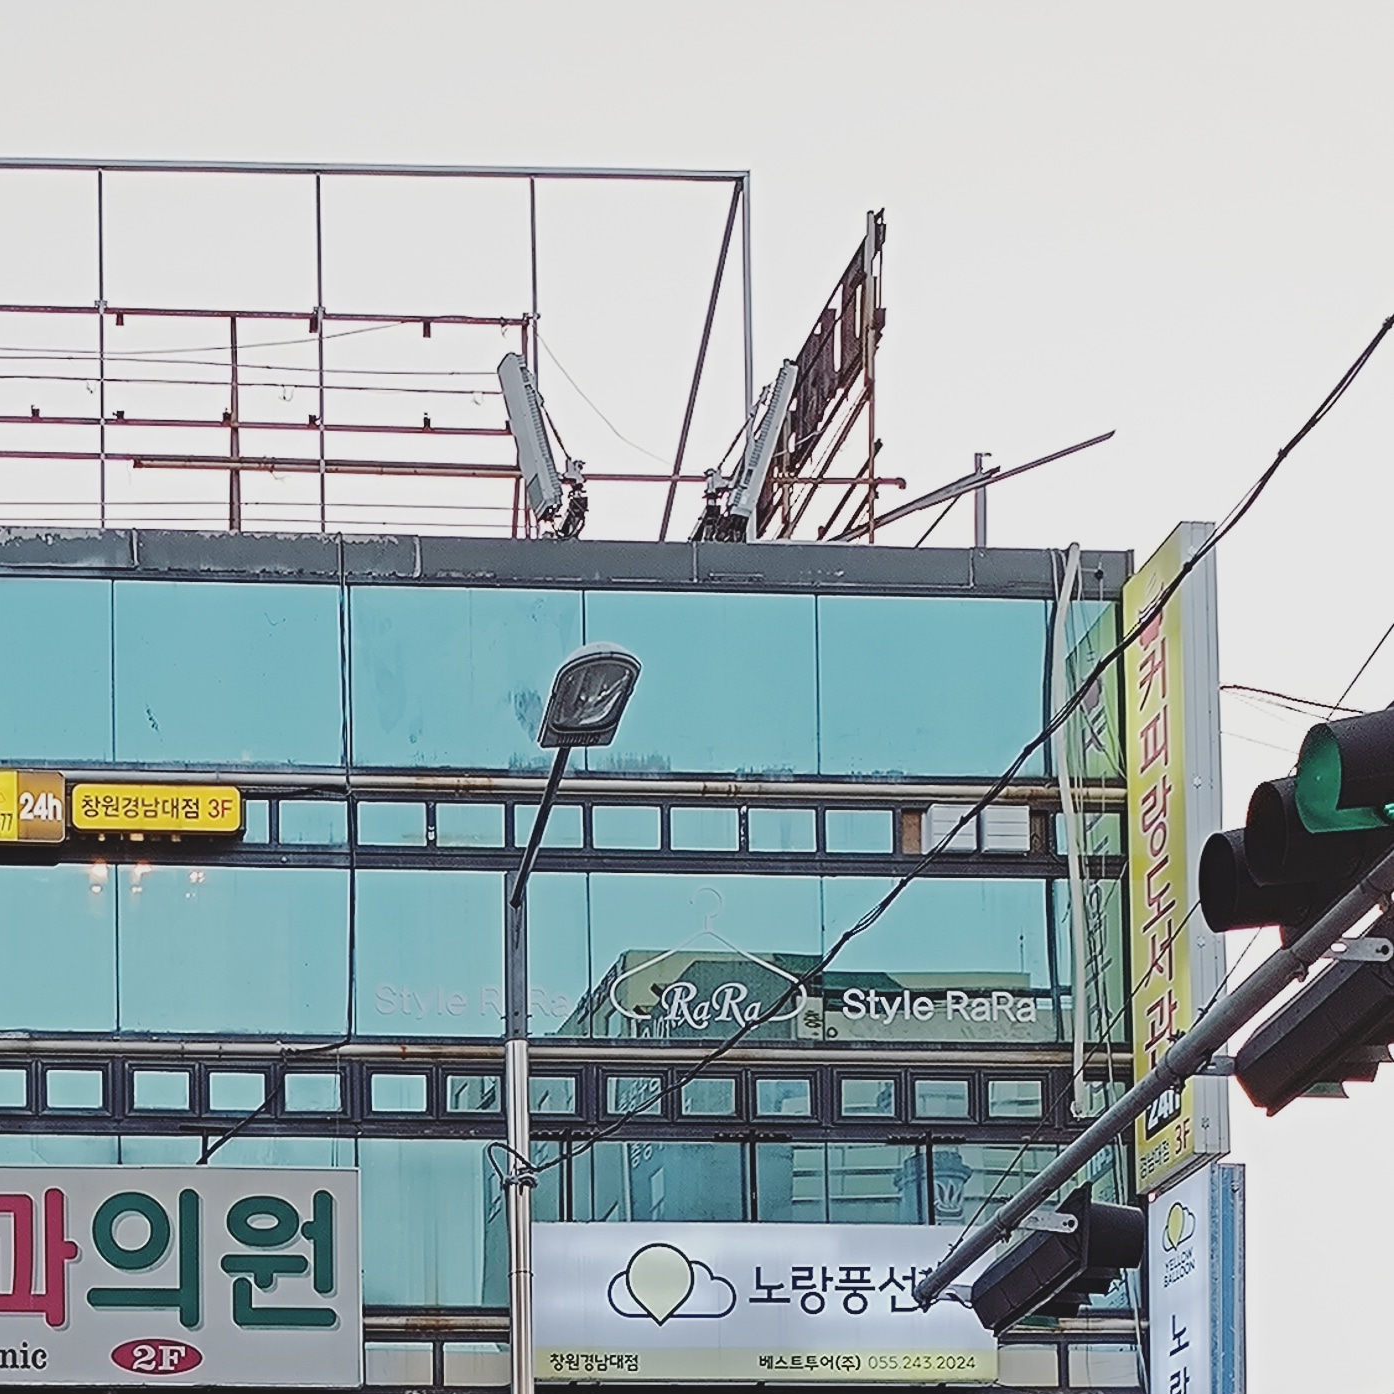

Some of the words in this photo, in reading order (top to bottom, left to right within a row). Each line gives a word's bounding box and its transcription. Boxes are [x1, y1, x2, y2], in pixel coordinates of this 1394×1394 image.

[19, 791, 63, 821] 24h
[81, 797, 200, 819] 창원경남대점
[208, 799, 233, 819] 3F
[1139, 637, 1176, 1070] 커피랑도서관
[375, 984, 467, 1021] Style
[480, 985, 572, 1018] RRa
[661, 981, 762, 1030] RaRa
[842, 988, 934, 1026] Style
[945, 991, 1037, 1022] RaRa
[1175, 1118, 1191, 1154] 3F
[1163, 1259, 1197, 1288] BALLOON
[1164, 1246, 1194, 1272] YELLOW
[749, 1266, 920, 1315] 노랑풍선
[131, 1344, 186, 1372] 2F
[549, 1353, 640, 1372] 창원경남대점
[759, 1354, 861, 1372] 베스트투어(주)
[869, 1355, 976, 1371] 055.243.2024
